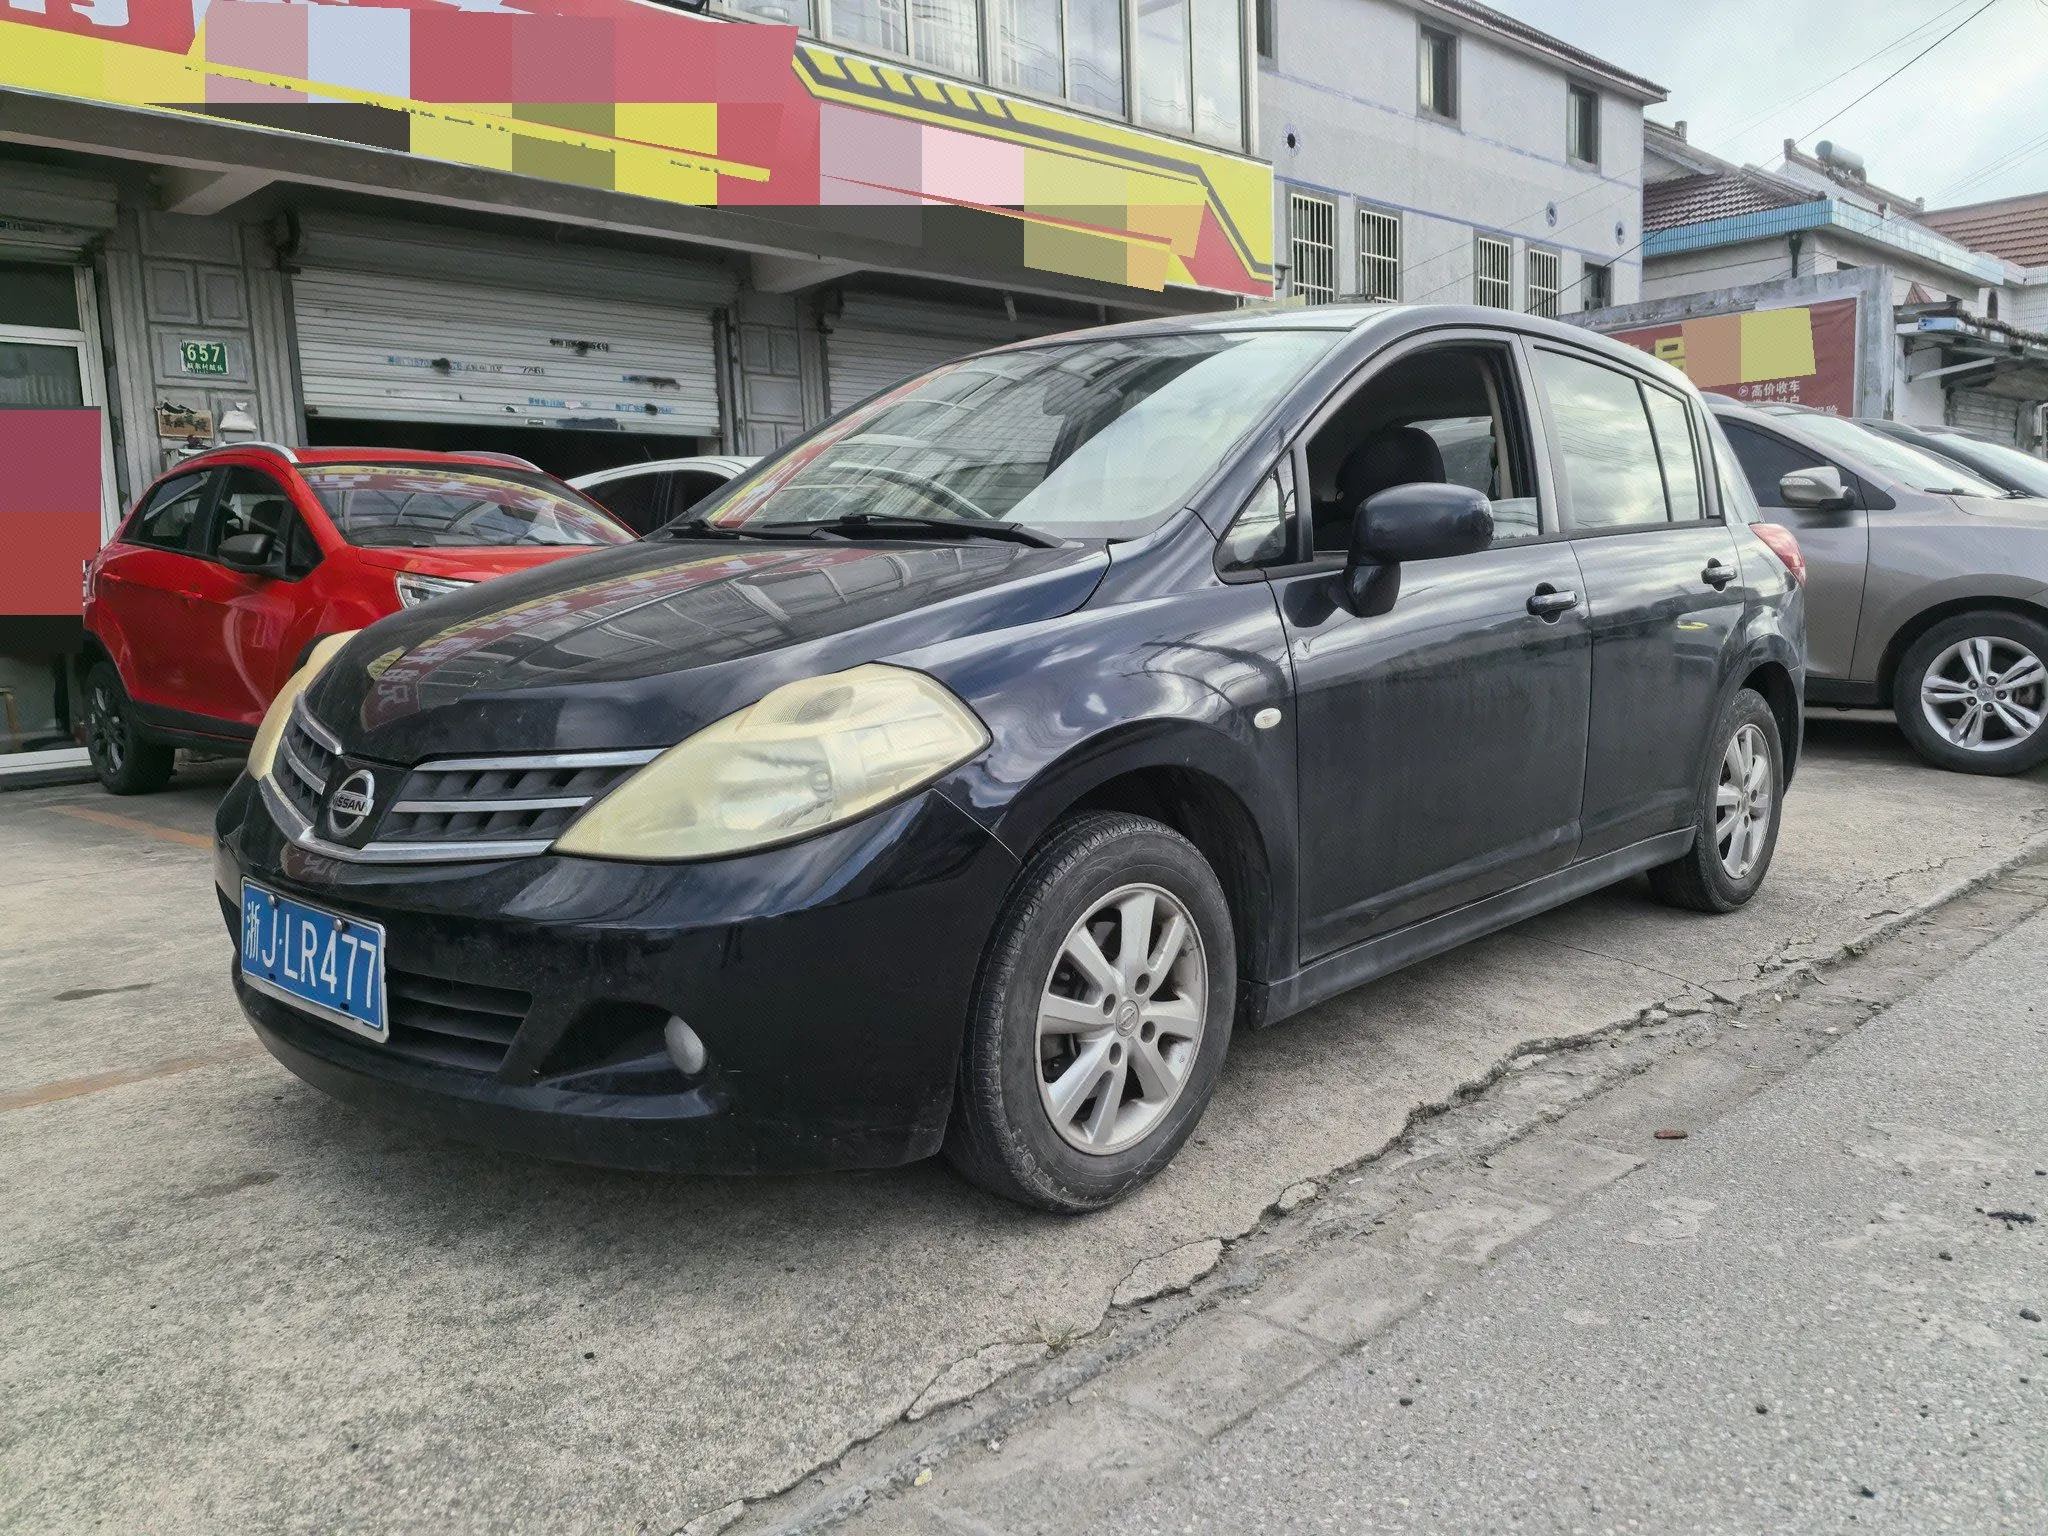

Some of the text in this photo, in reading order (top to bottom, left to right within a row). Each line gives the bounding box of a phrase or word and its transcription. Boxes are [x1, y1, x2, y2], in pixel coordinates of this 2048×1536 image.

[187, 344, 220, 362] 657
[1751, 380, 1800, 398] 高价收车
